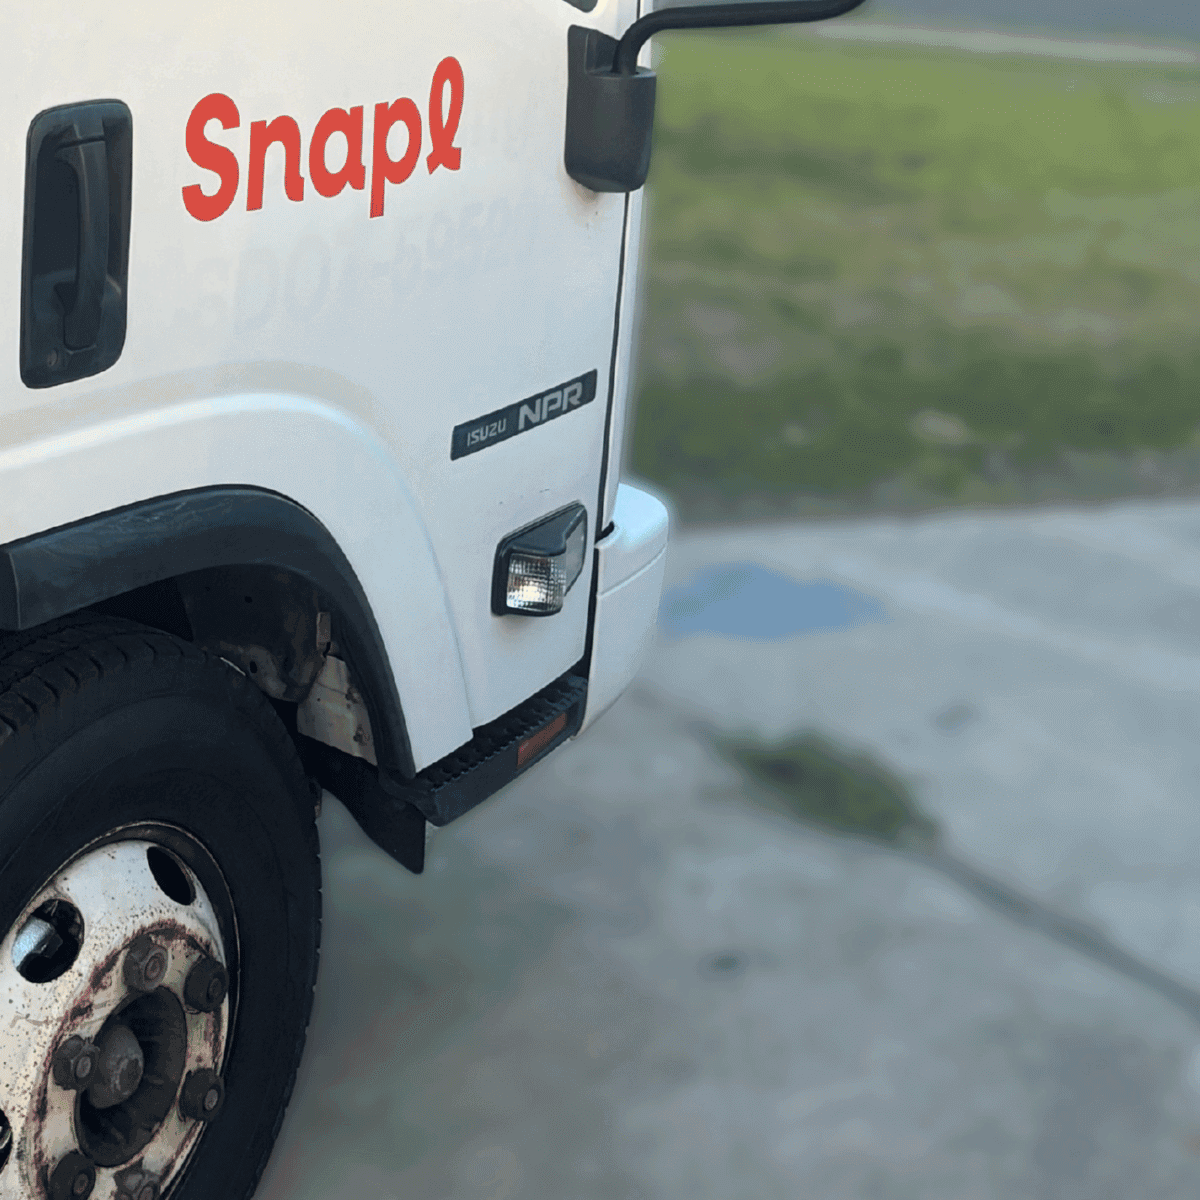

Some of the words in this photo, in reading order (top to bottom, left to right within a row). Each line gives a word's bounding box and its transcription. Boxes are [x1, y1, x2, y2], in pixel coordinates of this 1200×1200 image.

[182, 56, 464, 221] Snapl
[467, 418, 506, 446] ISUZU
[518, 382, 582, 431] NPR
